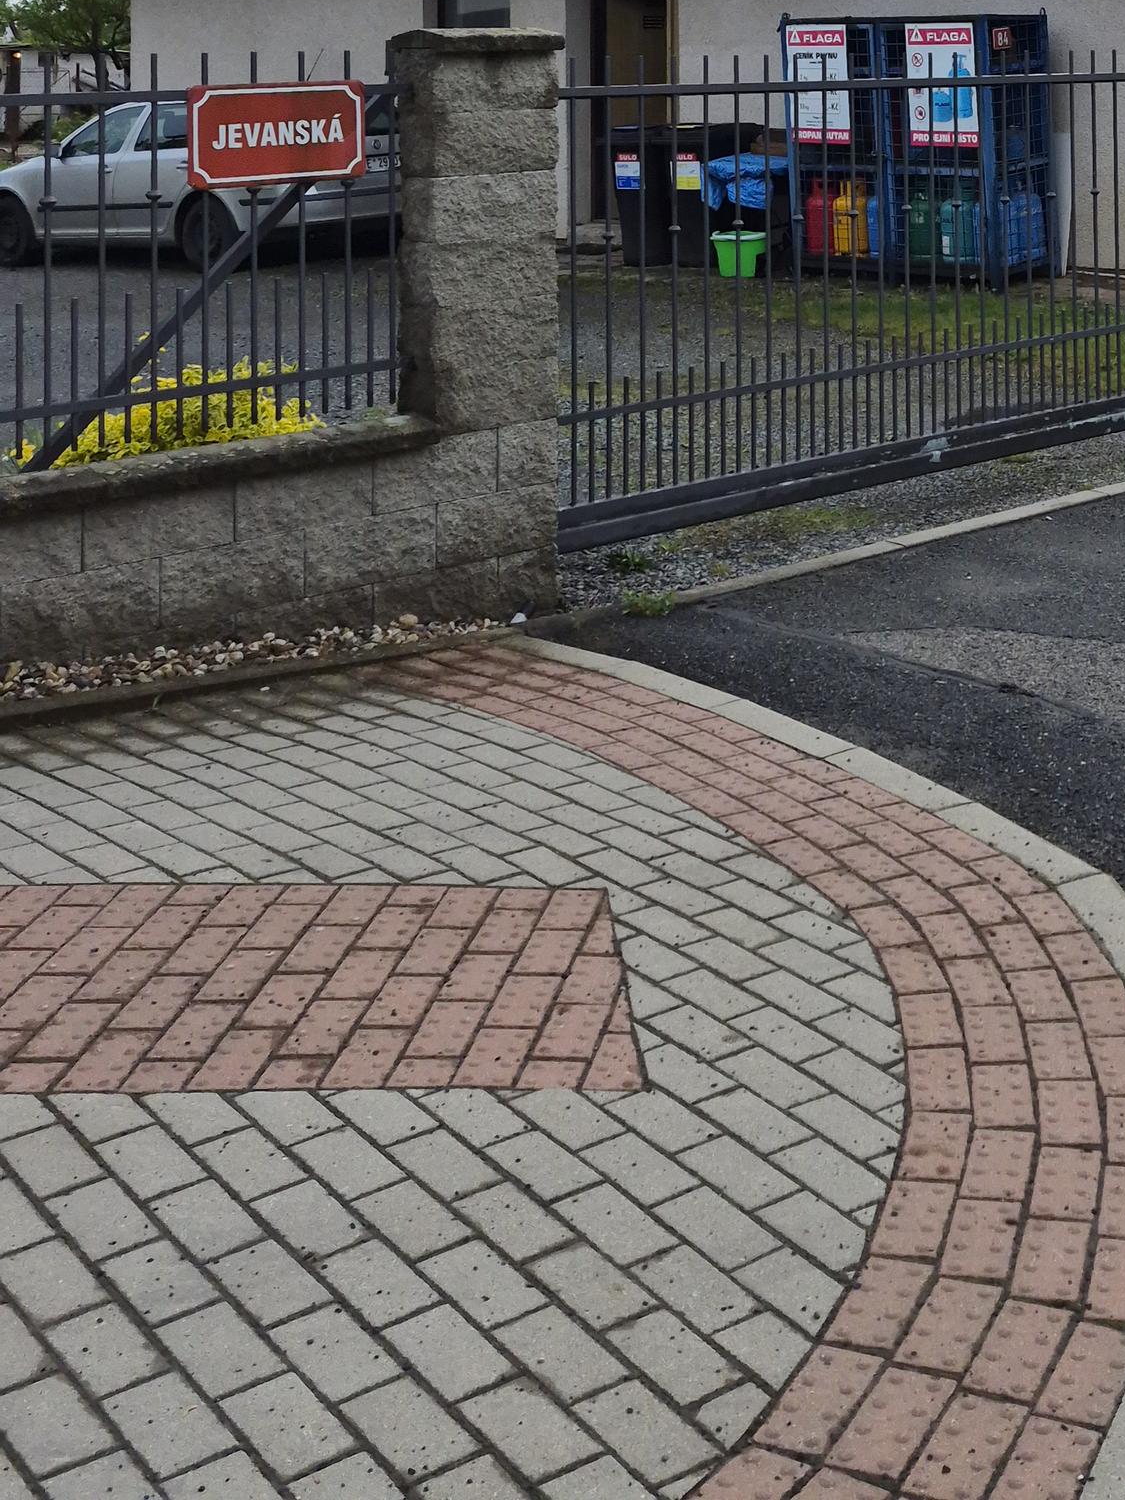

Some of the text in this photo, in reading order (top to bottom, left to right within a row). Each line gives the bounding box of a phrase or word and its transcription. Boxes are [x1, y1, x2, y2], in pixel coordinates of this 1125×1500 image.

[803, 33, 842, 44] FLAGA
[926, 31, 969, 42] FLAGA
[212, 113, 345, 150] JEVANSKÁ
